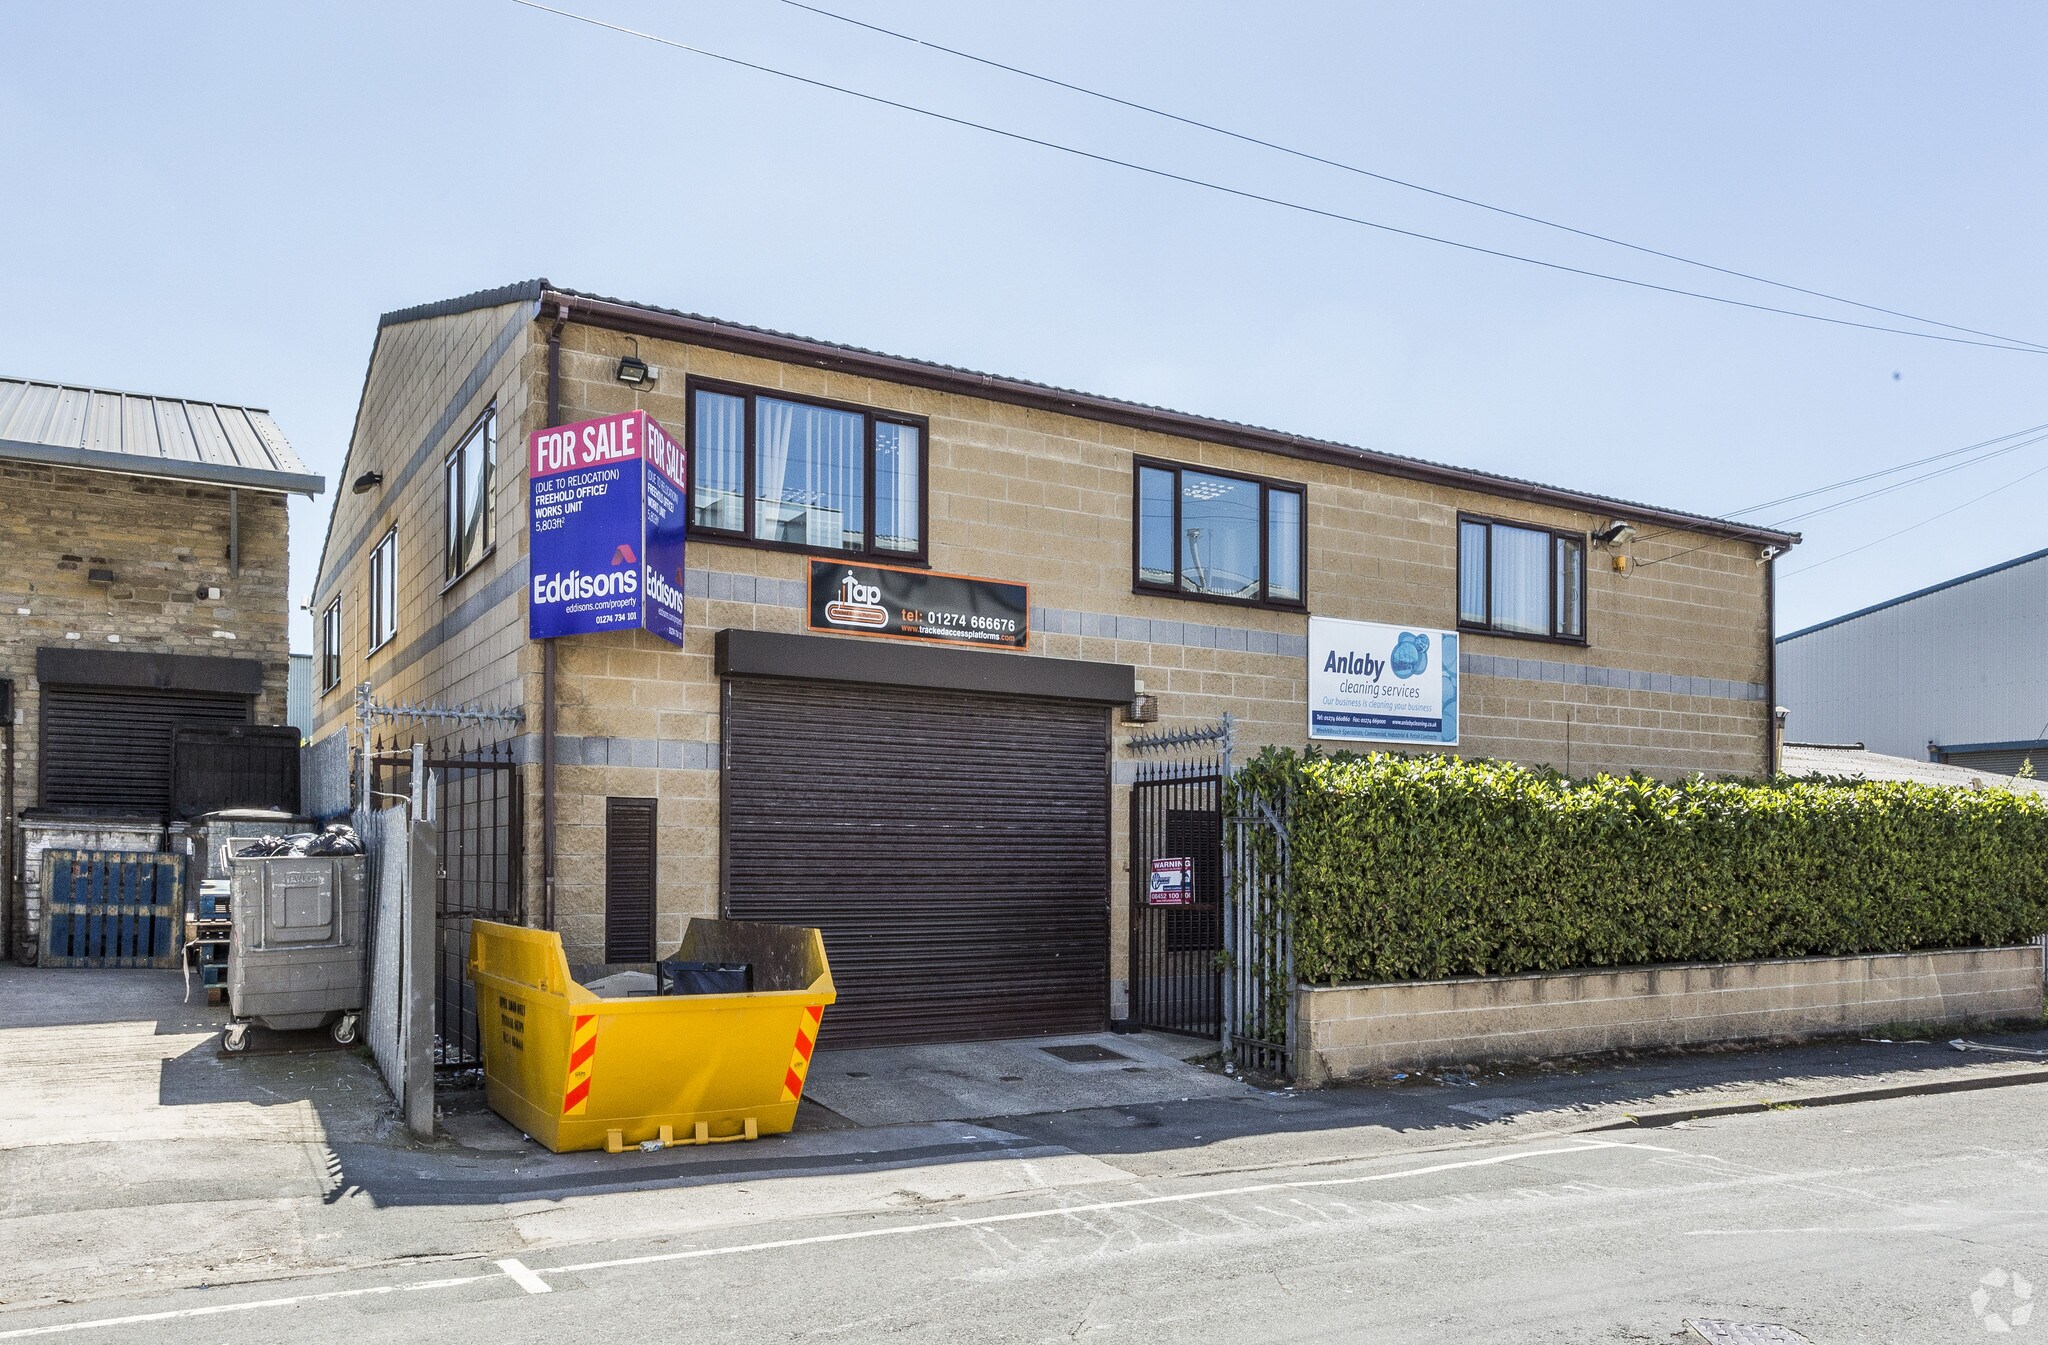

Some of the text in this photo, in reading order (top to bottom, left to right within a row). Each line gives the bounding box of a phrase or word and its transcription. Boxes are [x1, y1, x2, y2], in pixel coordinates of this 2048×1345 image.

[537, 418, 635, 472] FOR SALE
[648, 422, 685, 489] FOR SALE
[535, 469, 620, 494] (DUE TO RELOCATION)
[535, 484, 608, 506] FREEHOLD OFFICE/
[535, 501, 583, 519] WORKS UNIT
[534, 569, 637, 604] Eddisons
[646, 564, 683, 614] Eddisons
[565, 597, 636, 614] eddisons.com/property
[595, 612, 637, 624] 01274 734 101
[901, 609, 923, 622] tel:
[927, 611, 966, 627] 01274
[970, 616, 1015, 632] 666676
[901, 624, 1016, 642] www.trackedaccessplatforms.com
[1323, 650, 1385, 683] Anlaby
[1339, 679, 1420, 698] cleaning services
[1322, 696, 1432, 712] Our business is cleaning your business
